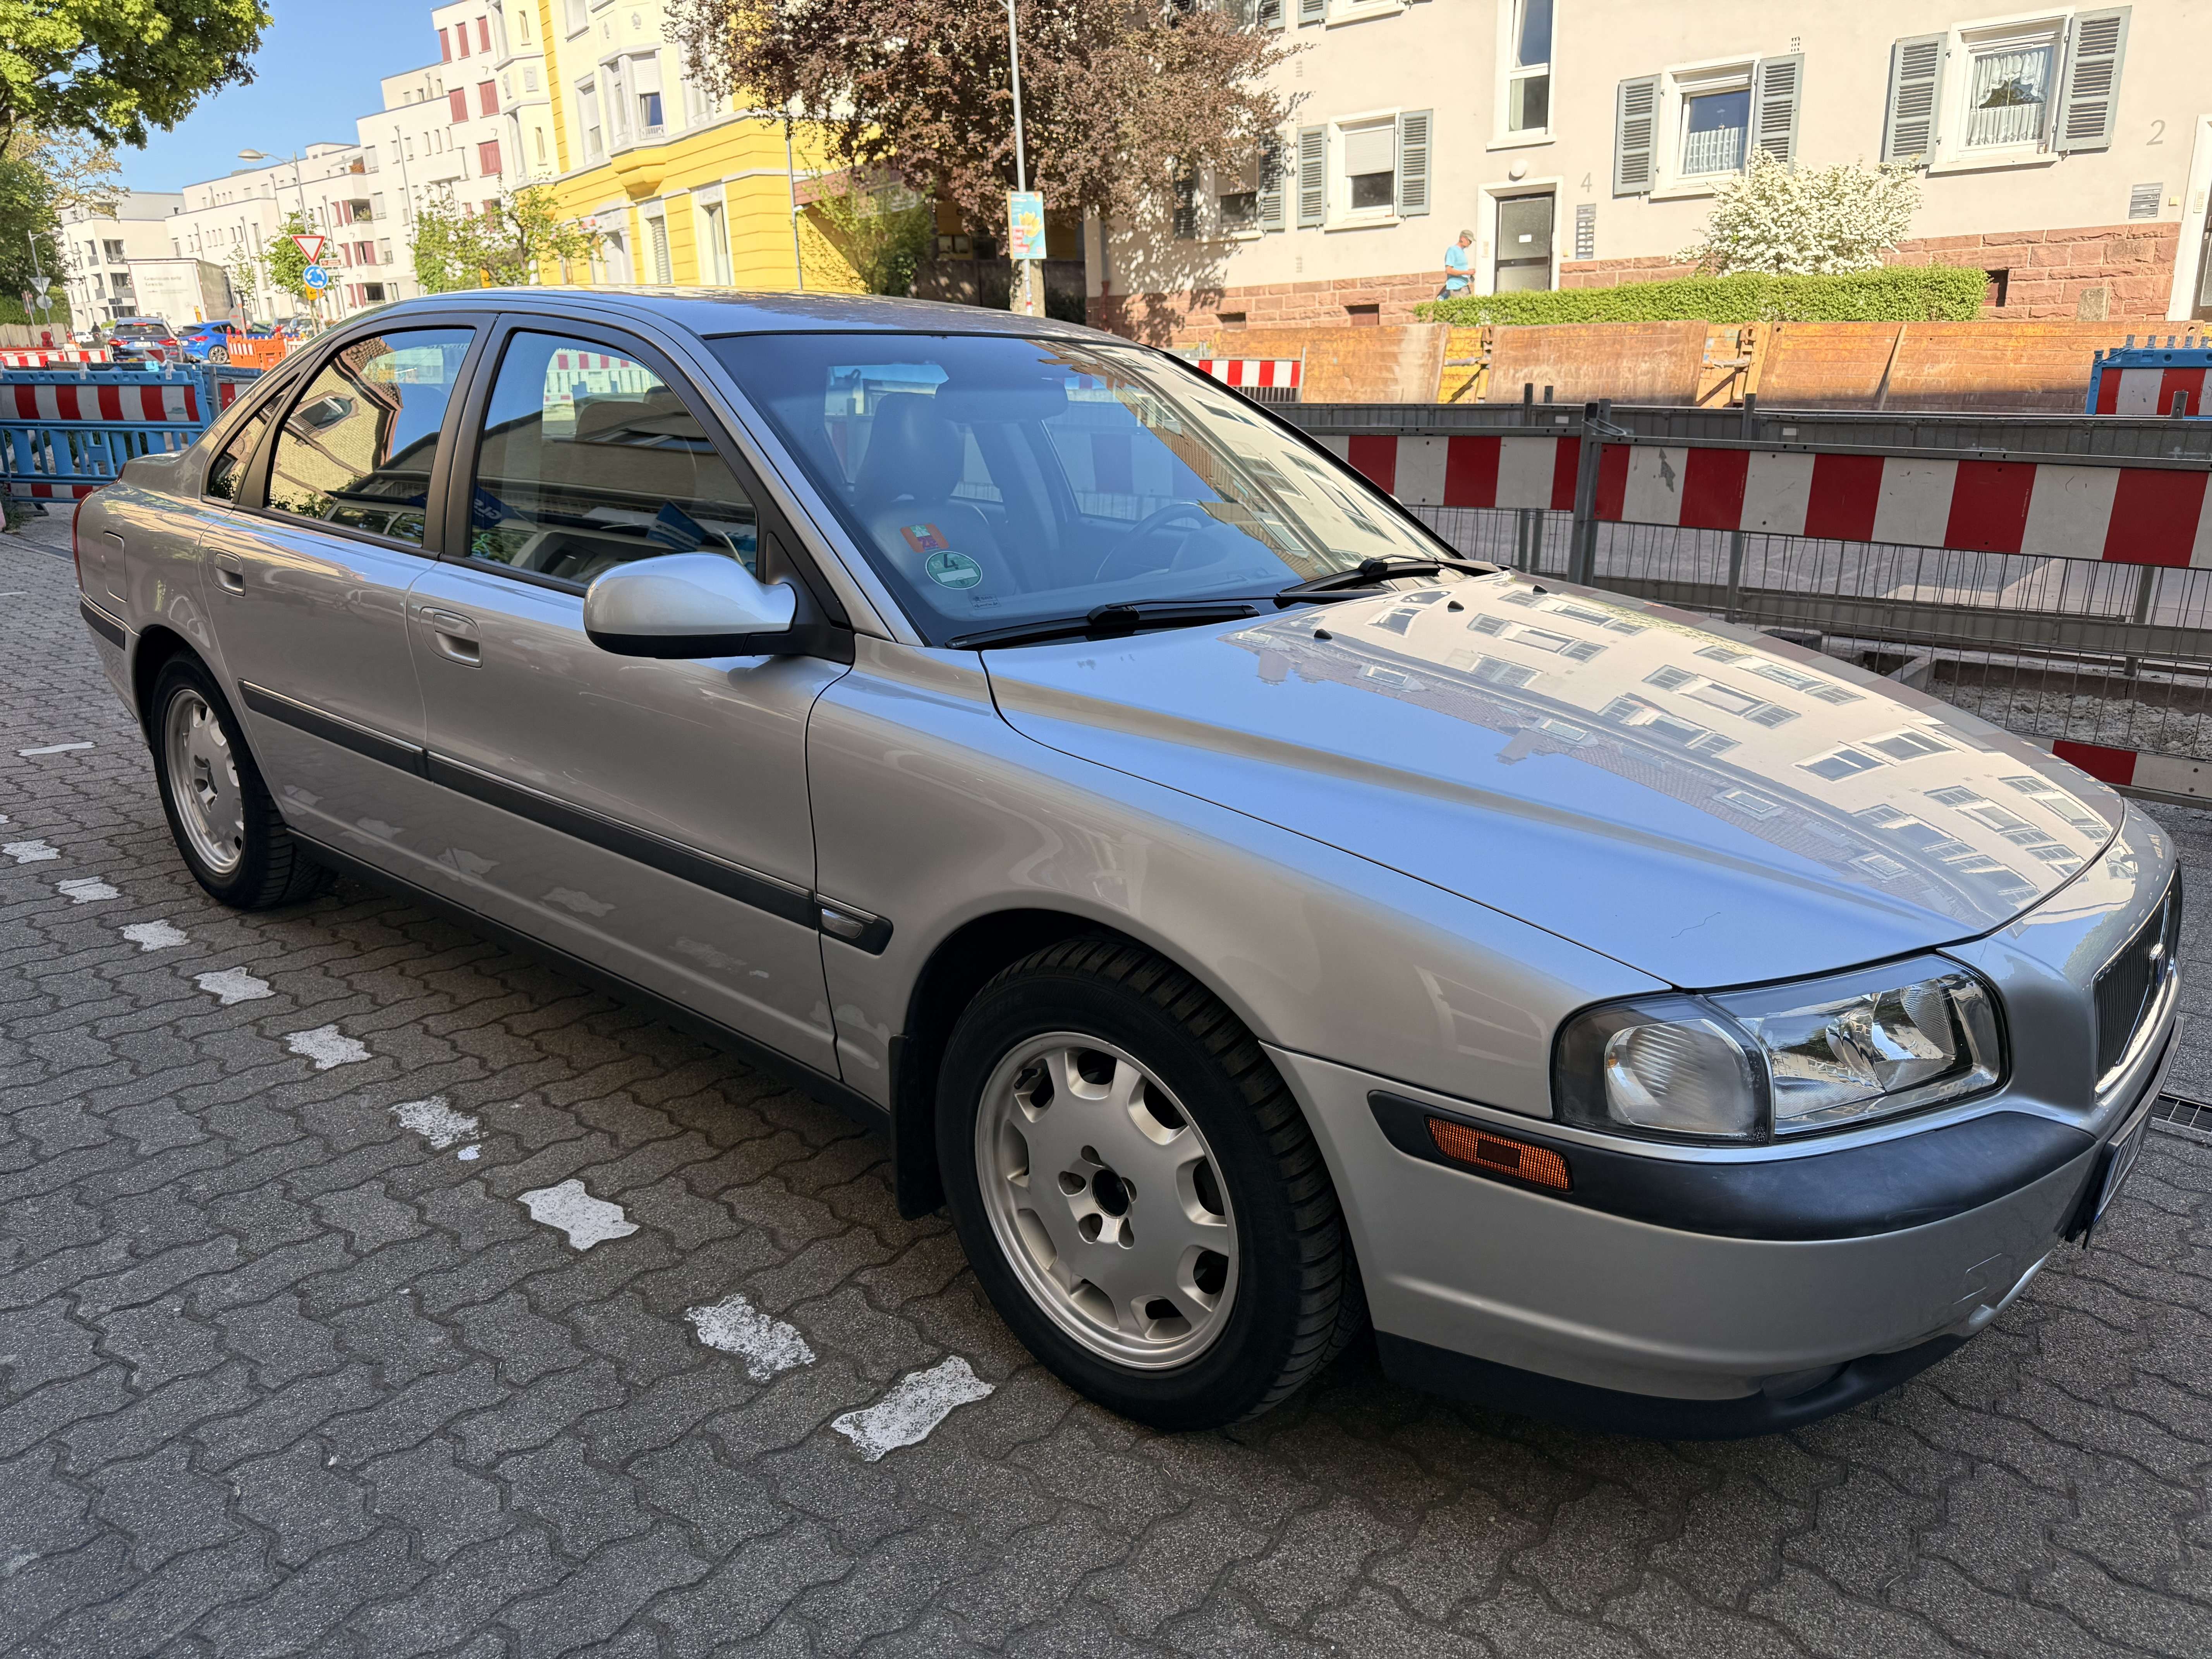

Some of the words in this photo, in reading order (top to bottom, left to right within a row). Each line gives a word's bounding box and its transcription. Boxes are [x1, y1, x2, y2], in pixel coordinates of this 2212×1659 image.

[2146, 119, 2166, 146] 2
[1580, 172, 1592, 193] 4
[944, 554, 959, 570] 4
